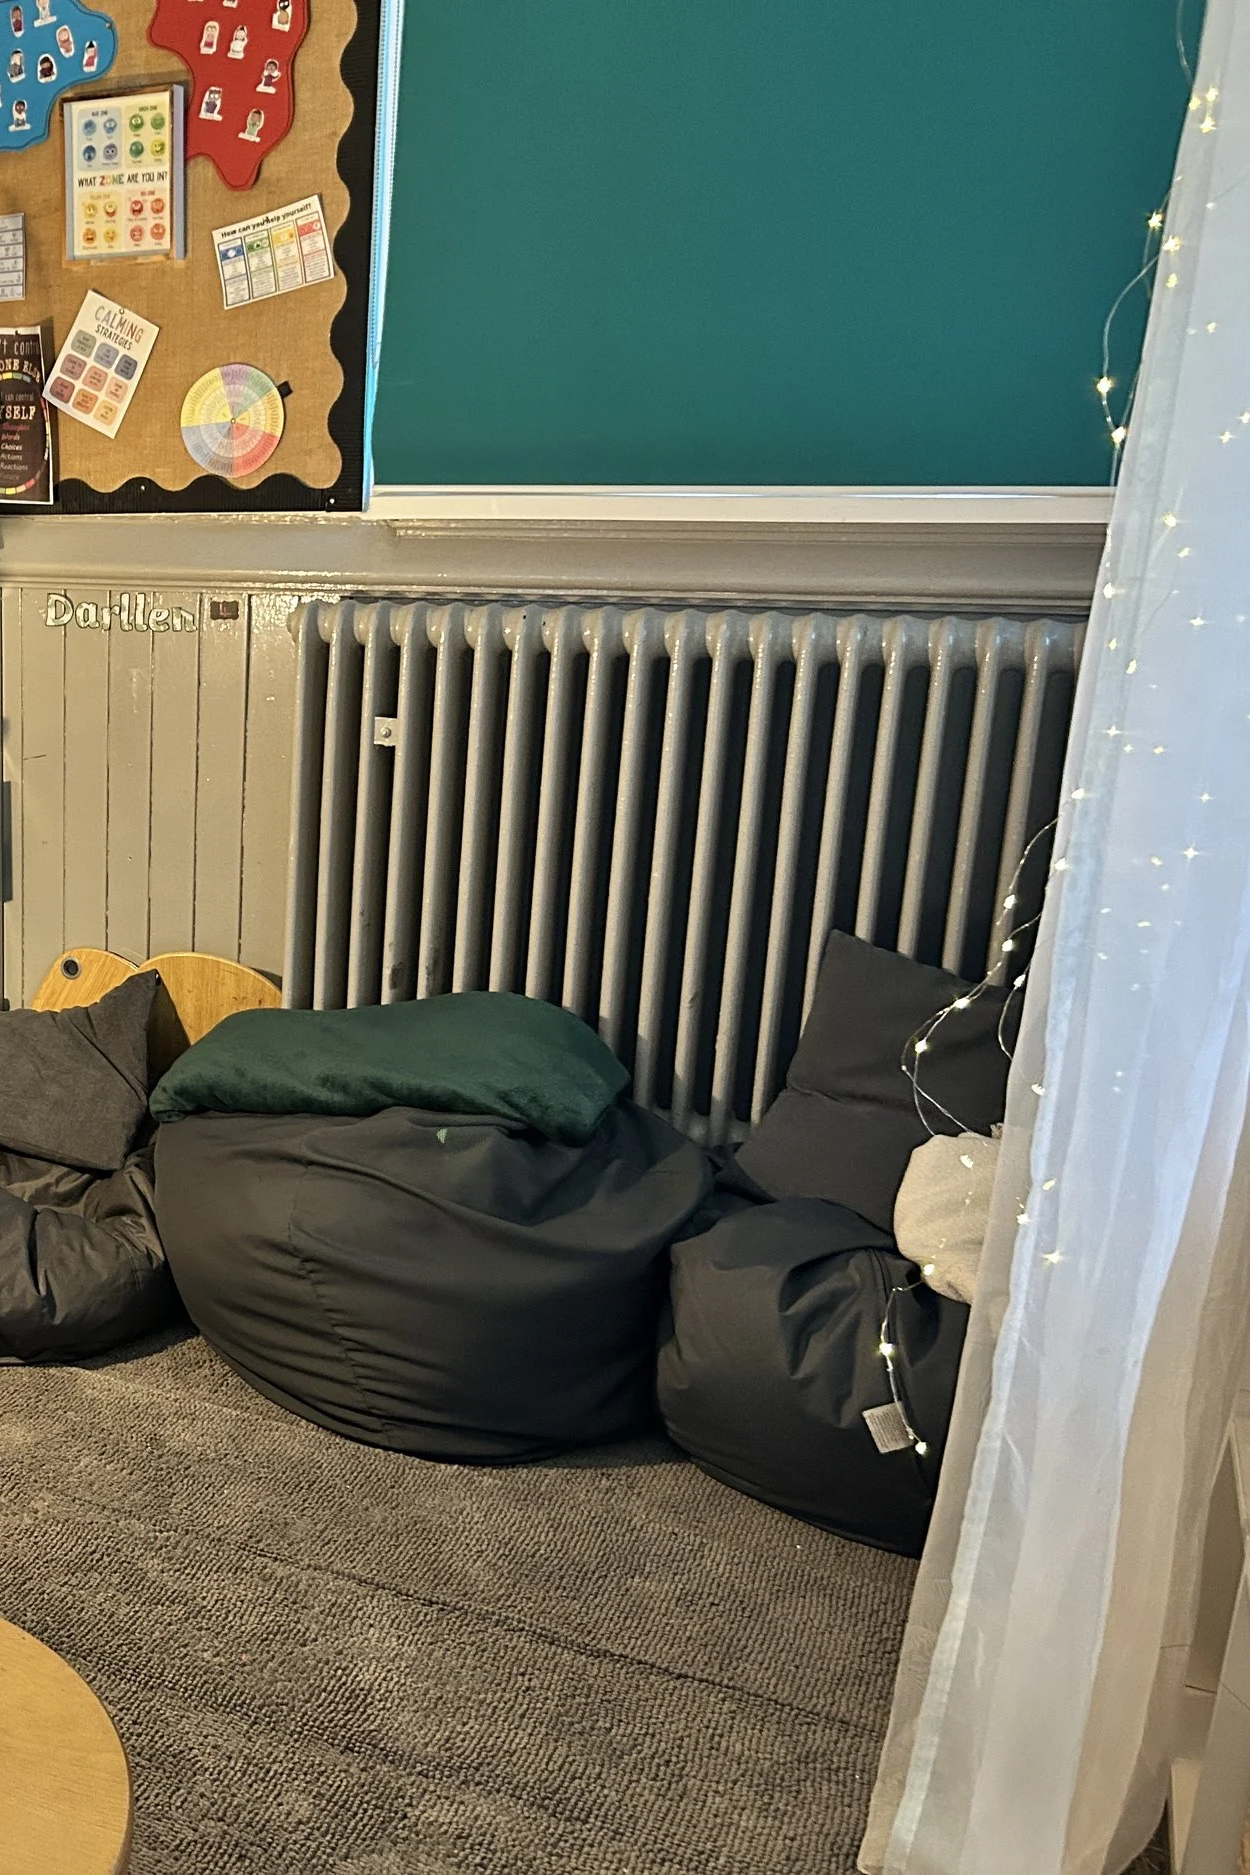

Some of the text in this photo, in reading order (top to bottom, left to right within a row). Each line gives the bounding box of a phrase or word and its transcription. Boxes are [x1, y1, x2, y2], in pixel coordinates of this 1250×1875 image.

[77, 171, 168, 188] WHAT ZONE ARE YOU IN?
[221, 229, 237, 239] How
[238, 225, 251, 234] can
[95, 305, 144, 344] CALMING
[95, 324, 133, 351] STRATEGIES
[44, 592, 199, 633] Darllen
